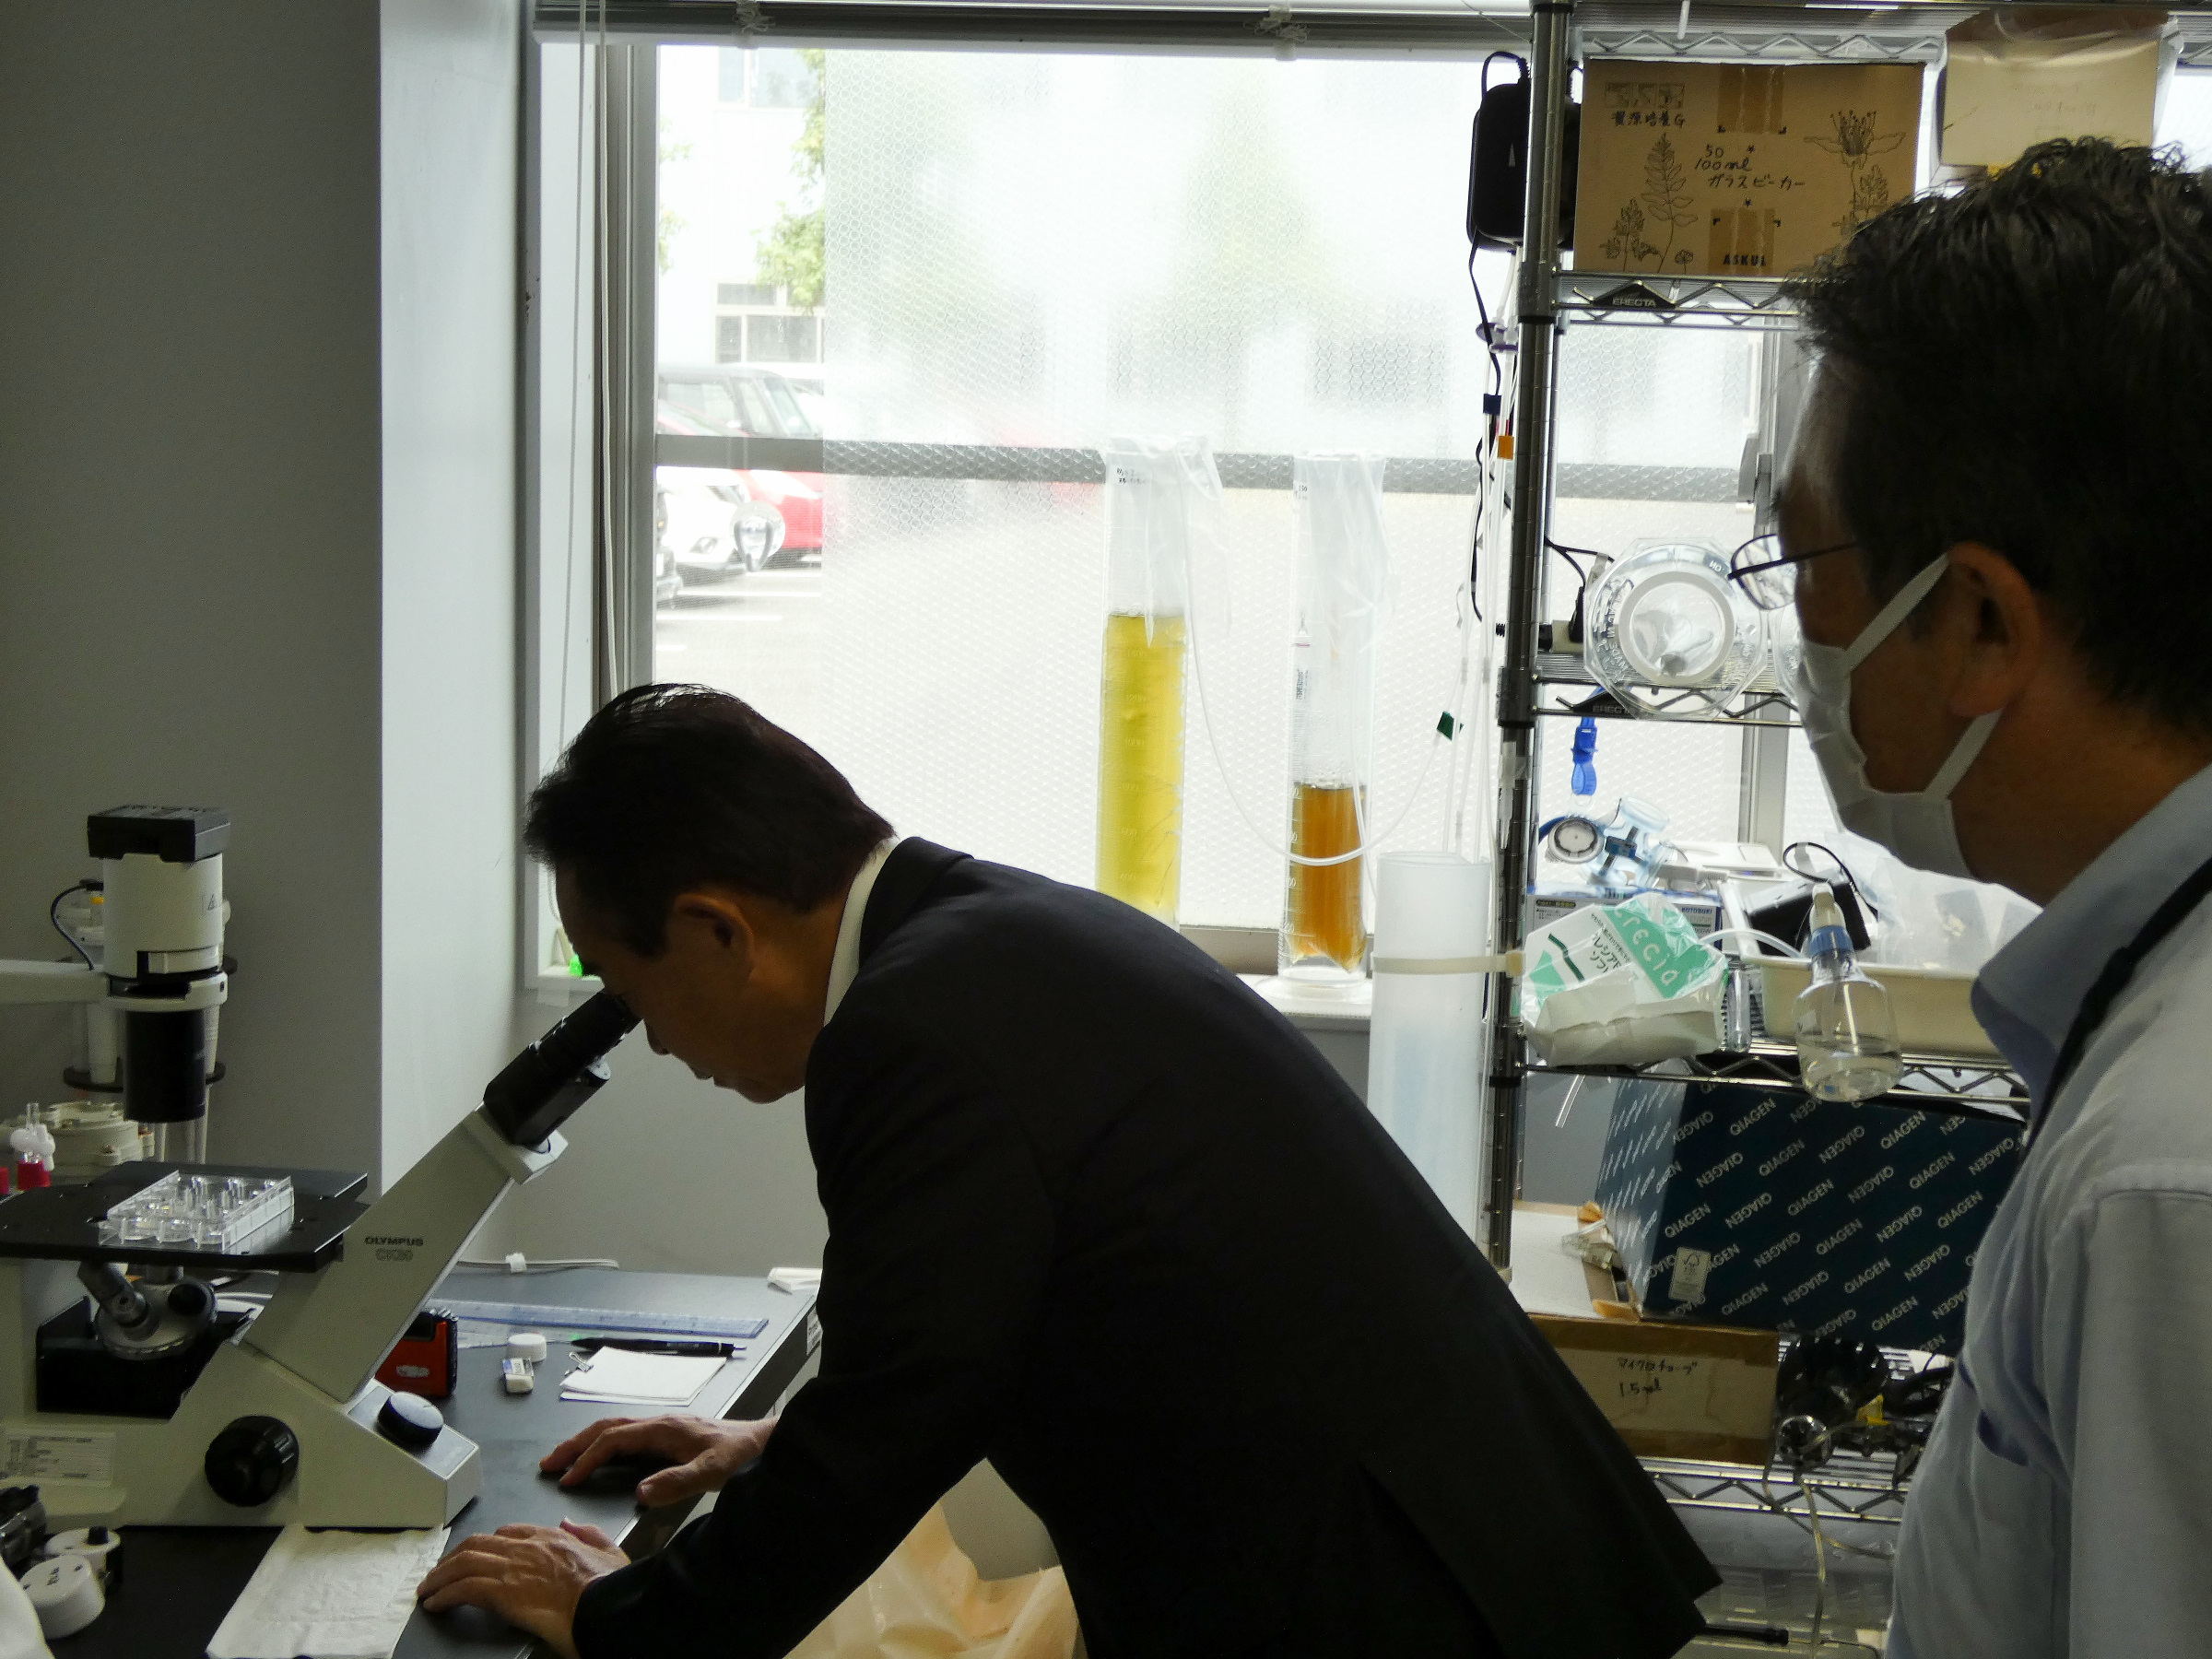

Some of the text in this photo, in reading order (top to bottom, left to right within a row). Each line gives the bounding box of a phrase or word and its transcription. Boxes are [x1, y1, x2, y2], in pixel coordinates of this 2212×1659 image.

[1723, 253, 1767, 267] ASKUL
[1730, 1097, 1777, 1135] QIAGEN
[1880, 1110, 1926, 1149] QIAGEN
[1759, 1139, 1805, 1176] QIAGEN
[1818, 1125, 1865, 1163] QIAGEN
[1968, 1137, 2015, 1175] QIAGEN
[1696, 1152, 1744, 1187] QIAGEN
[1848, 1166, 1894, 1204] QIAGEN
[1910, 1151, 1956, 1189] QIAGEN
[1724, 1192, 1772, 1229] QIAGEN
[1788, 1179, 1835, 1216] QIAGEN
[1937, 1191, 1983, 1228] QIAGEN
[1665, 1203, 1712, 1238] QIAGEN
[1816, 1218, 1864, 1255] QIAGEN
[1877, 1205, 1923, 1242] QIAGEN
[364, 1236, 423, 1246] OLYMPUS
[1754, 1232, 1801, 1267] QIAGEN
[1844, 1257, 1890, 1293] QIAGEN
[1904, 1244, 1950, 1281] QIAGEN
[1722, 1282, 1768, 1316] QIAGEN
[1782, 1270, 1830, 1305] QIAGEN
[1872, 1296, 1918, 1331] QIAGEN
